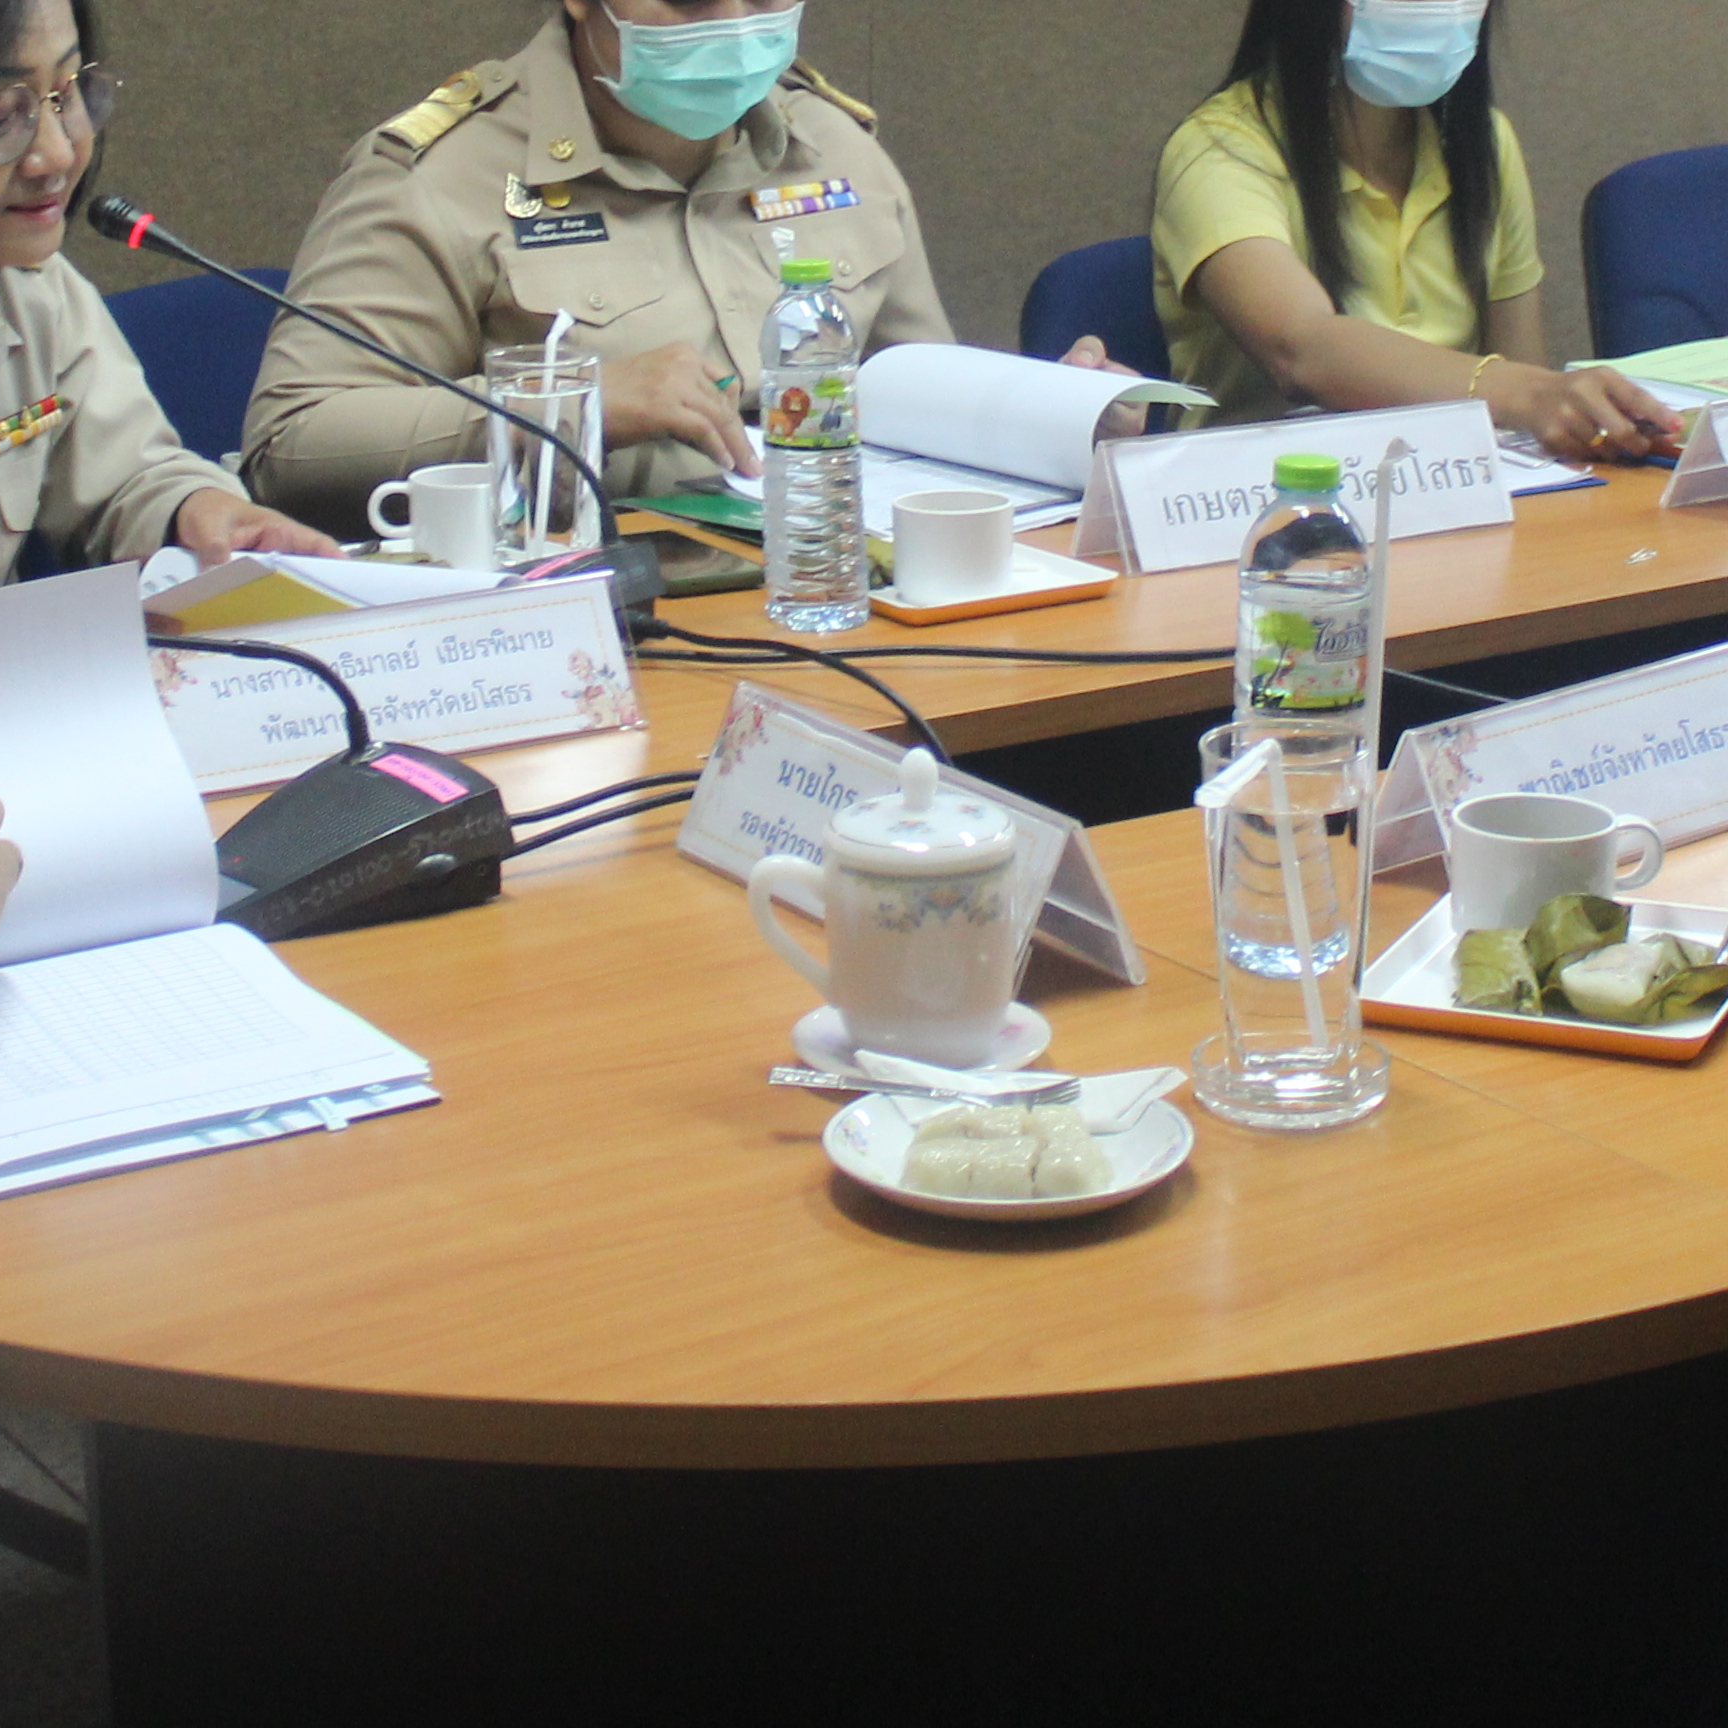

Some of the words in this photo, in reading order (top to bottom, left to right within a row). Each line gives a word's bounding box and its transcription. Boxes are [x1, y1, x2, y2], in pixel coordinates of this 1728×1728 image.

[1161, 448, 1494, 526] เกษตรวัดยโสธร
[260, 679, 533, 744] พัฒนารจังหวัดยโสธร
[776, 758, 860, 811] นายไกร
